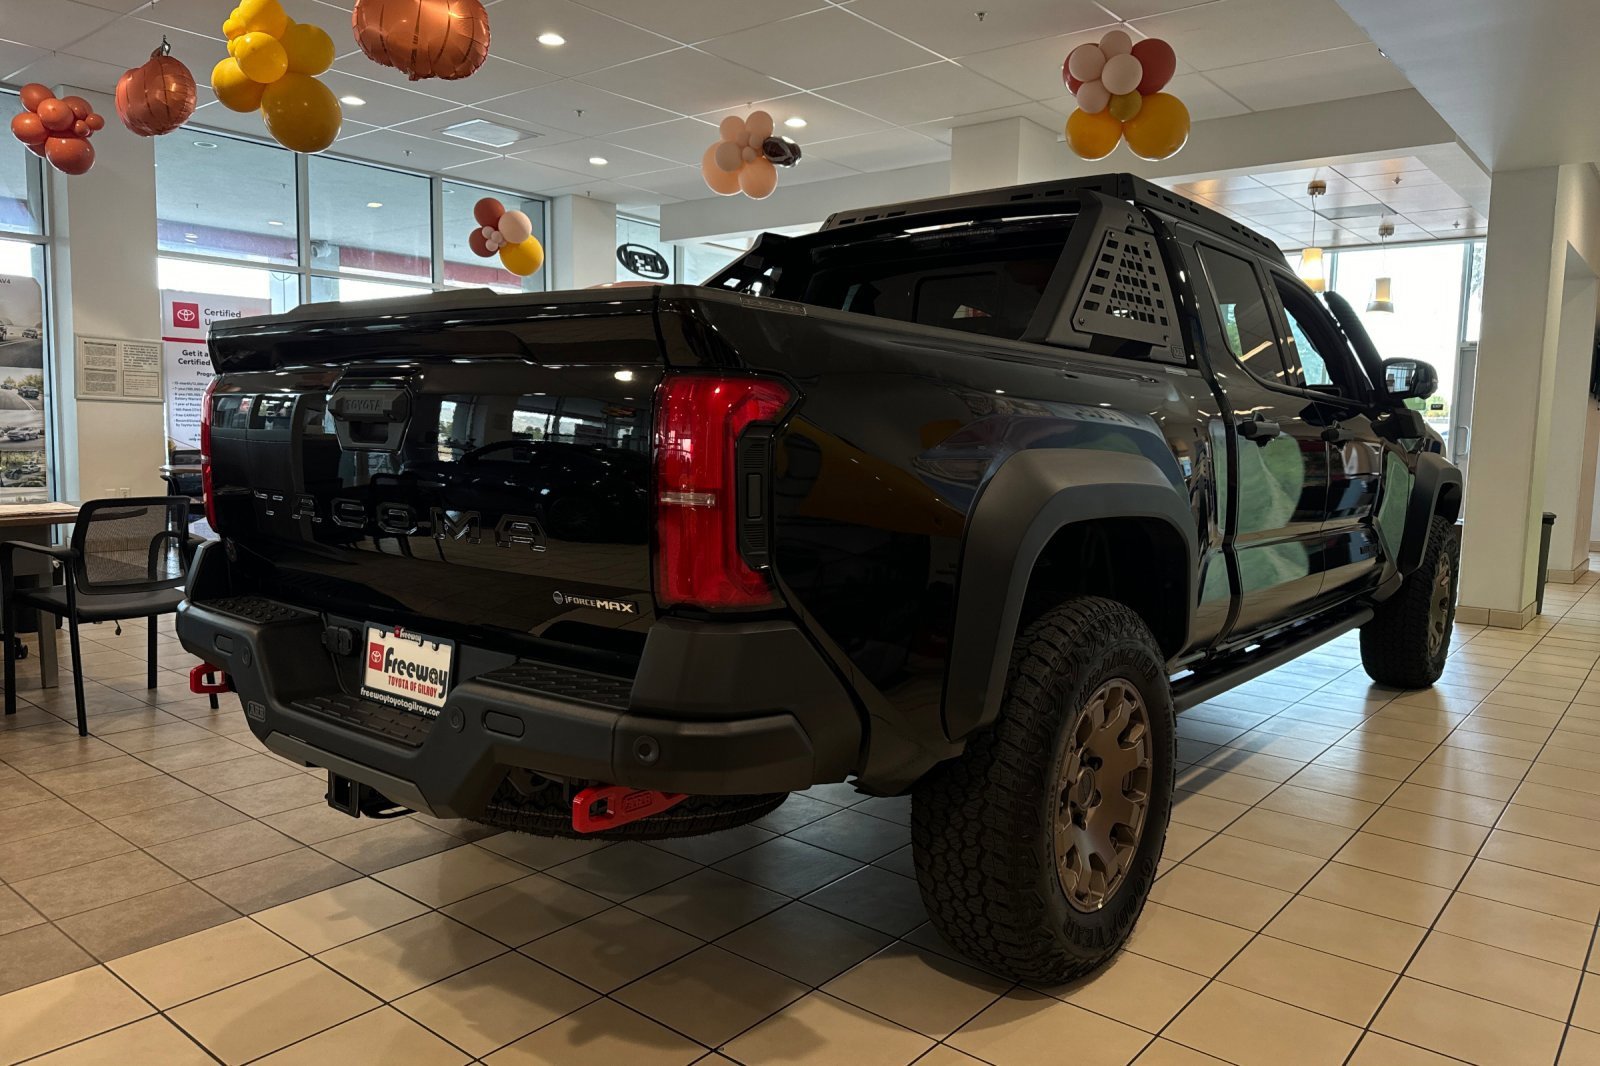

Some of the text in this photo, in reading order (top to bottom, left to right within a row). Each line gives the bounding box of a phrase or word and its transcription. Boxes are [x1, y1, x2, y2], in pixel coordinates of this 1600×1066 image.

[204, 308, 241, 318] Certified
[181, 349, 196, 357] Get
[177, 358, 211, 366] Certified
[345, 399, 384, 412] TOYOTA
[253, 488, 549, 553] TACOMA
[384, 647, 448, 699] freeway
[388, 675, 438, 698] TOYOTA OF GILROY
